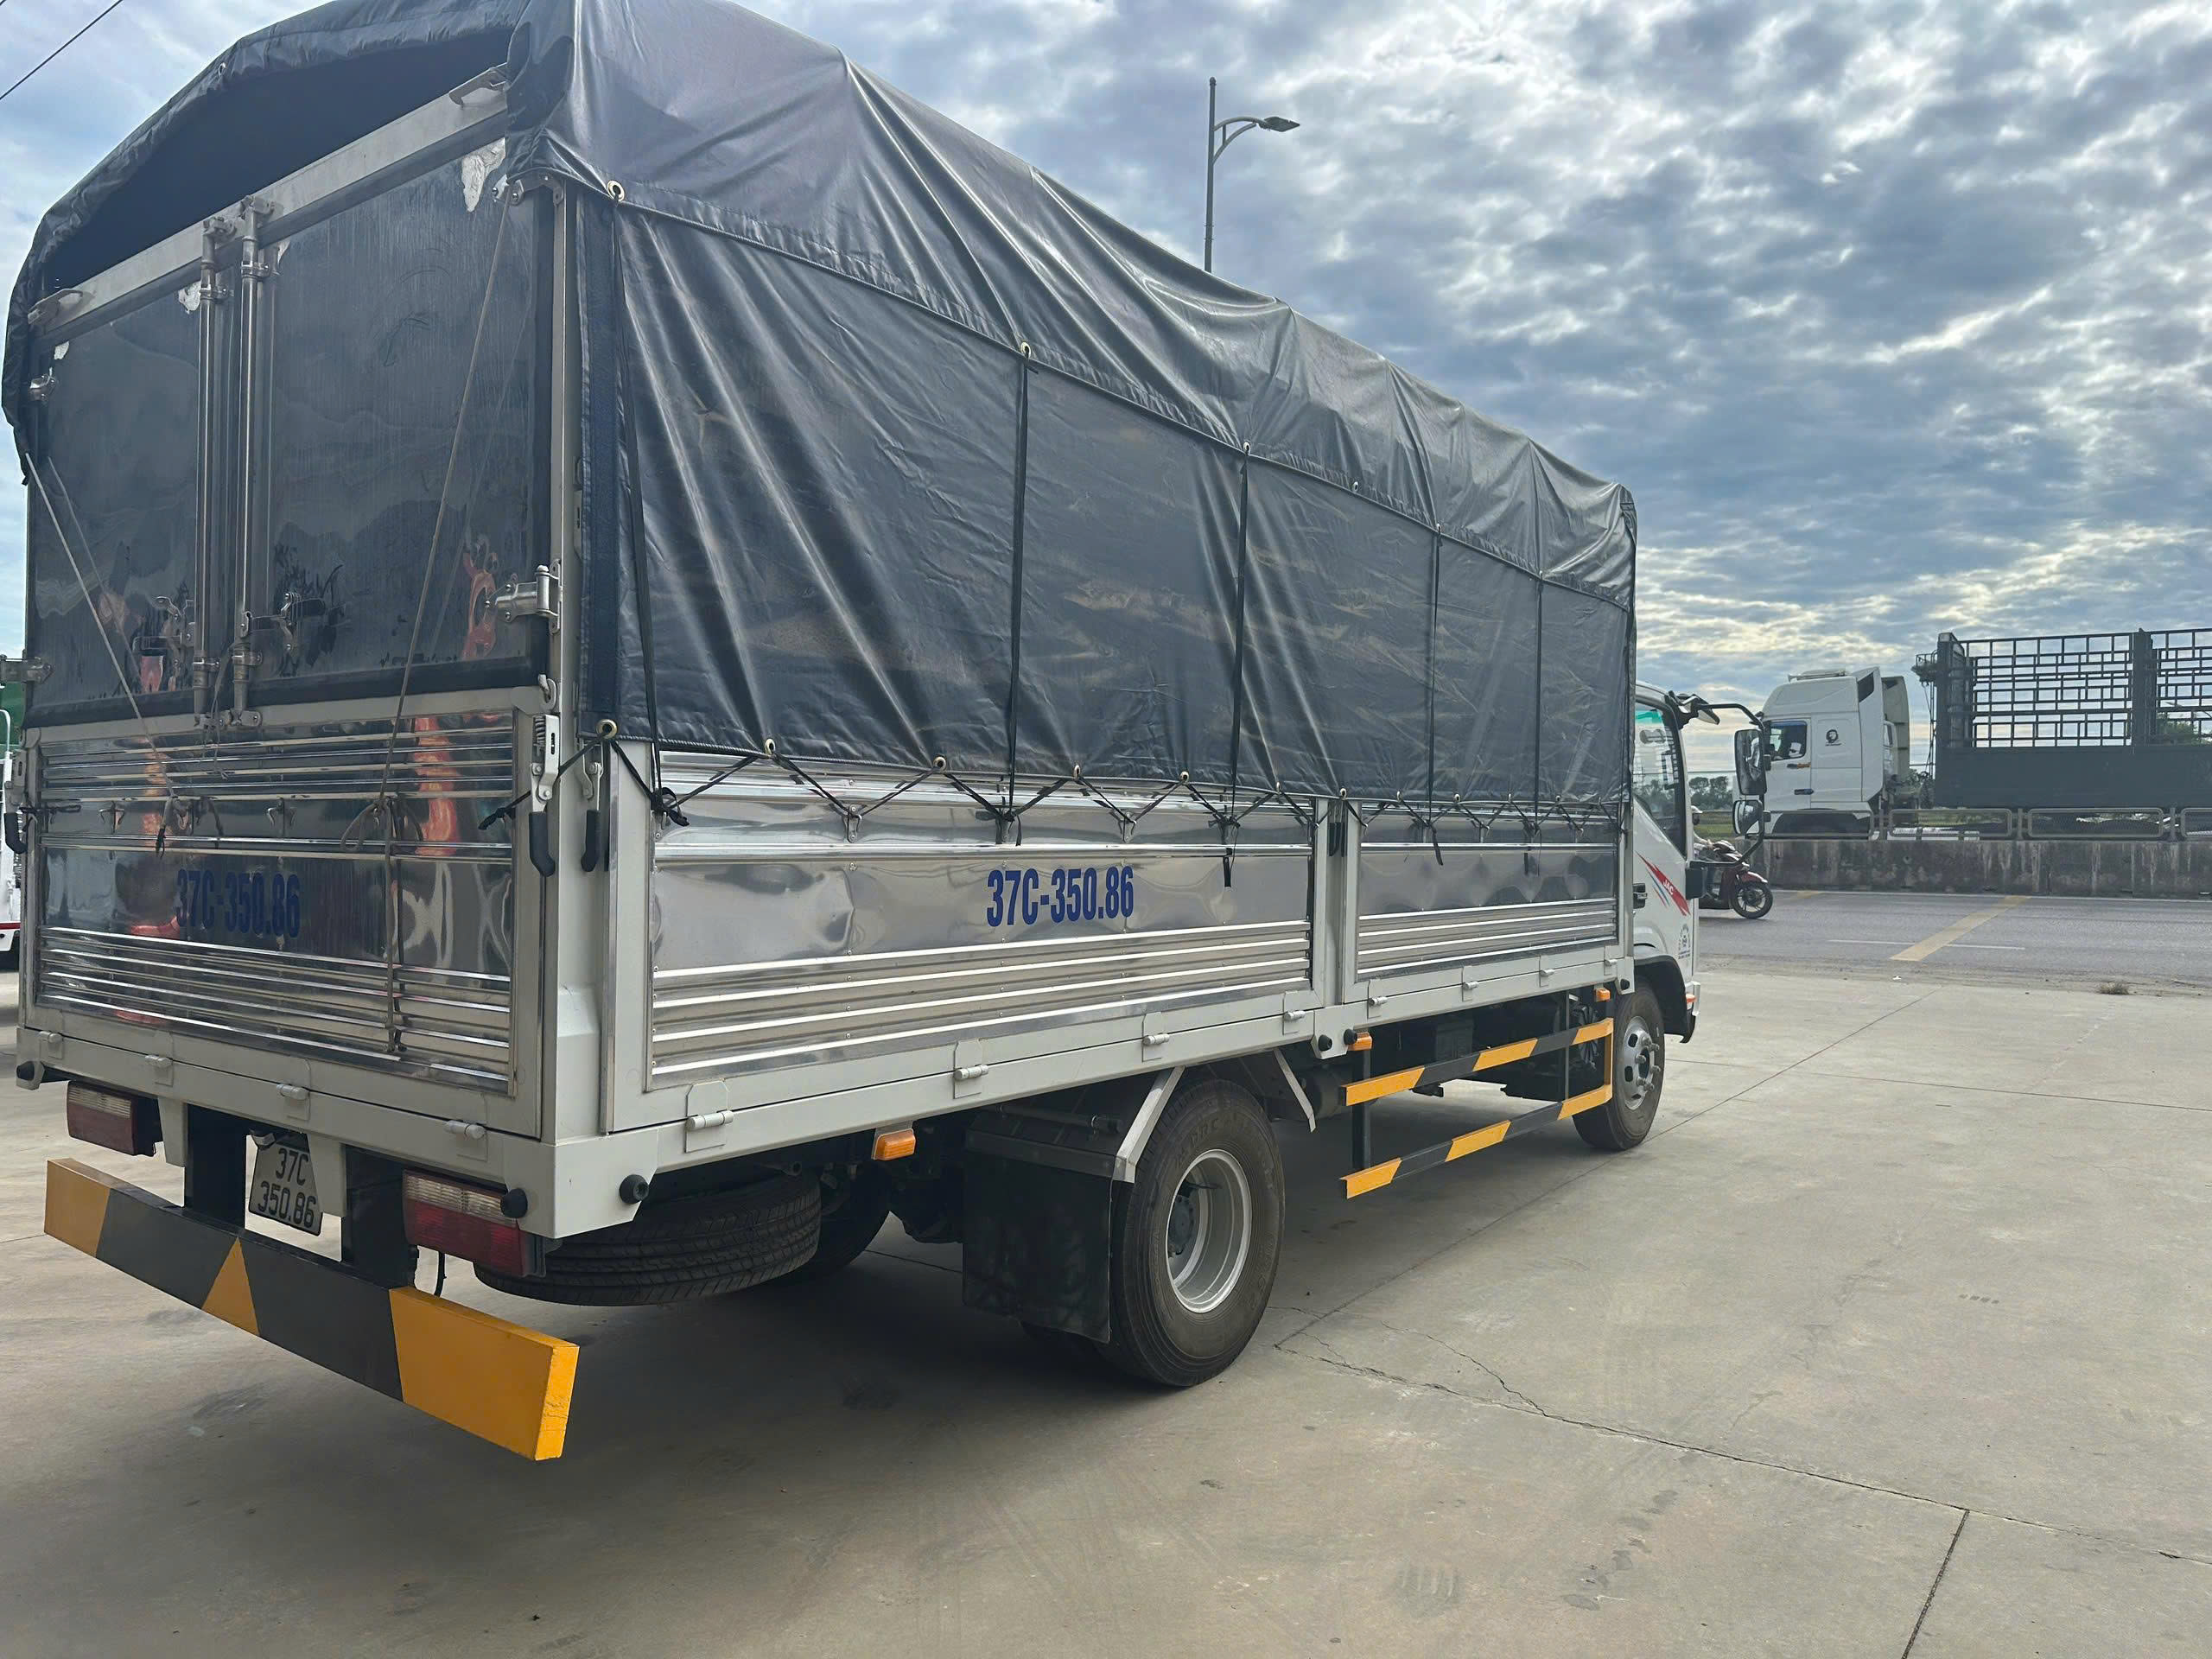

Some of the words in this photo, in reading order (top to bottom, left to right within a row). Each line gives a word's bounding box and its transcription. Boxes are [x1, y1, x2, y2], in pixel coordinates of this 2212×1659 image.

[177, 868, 301, 938] 37C-350.86
[987, 866, 1135, 927] 37C-350.86
[1663, 879, 1674, 895] JAC
[276, 1147, 309, 1186] 37C
[258, 1180, 316, 1228] 350.86
